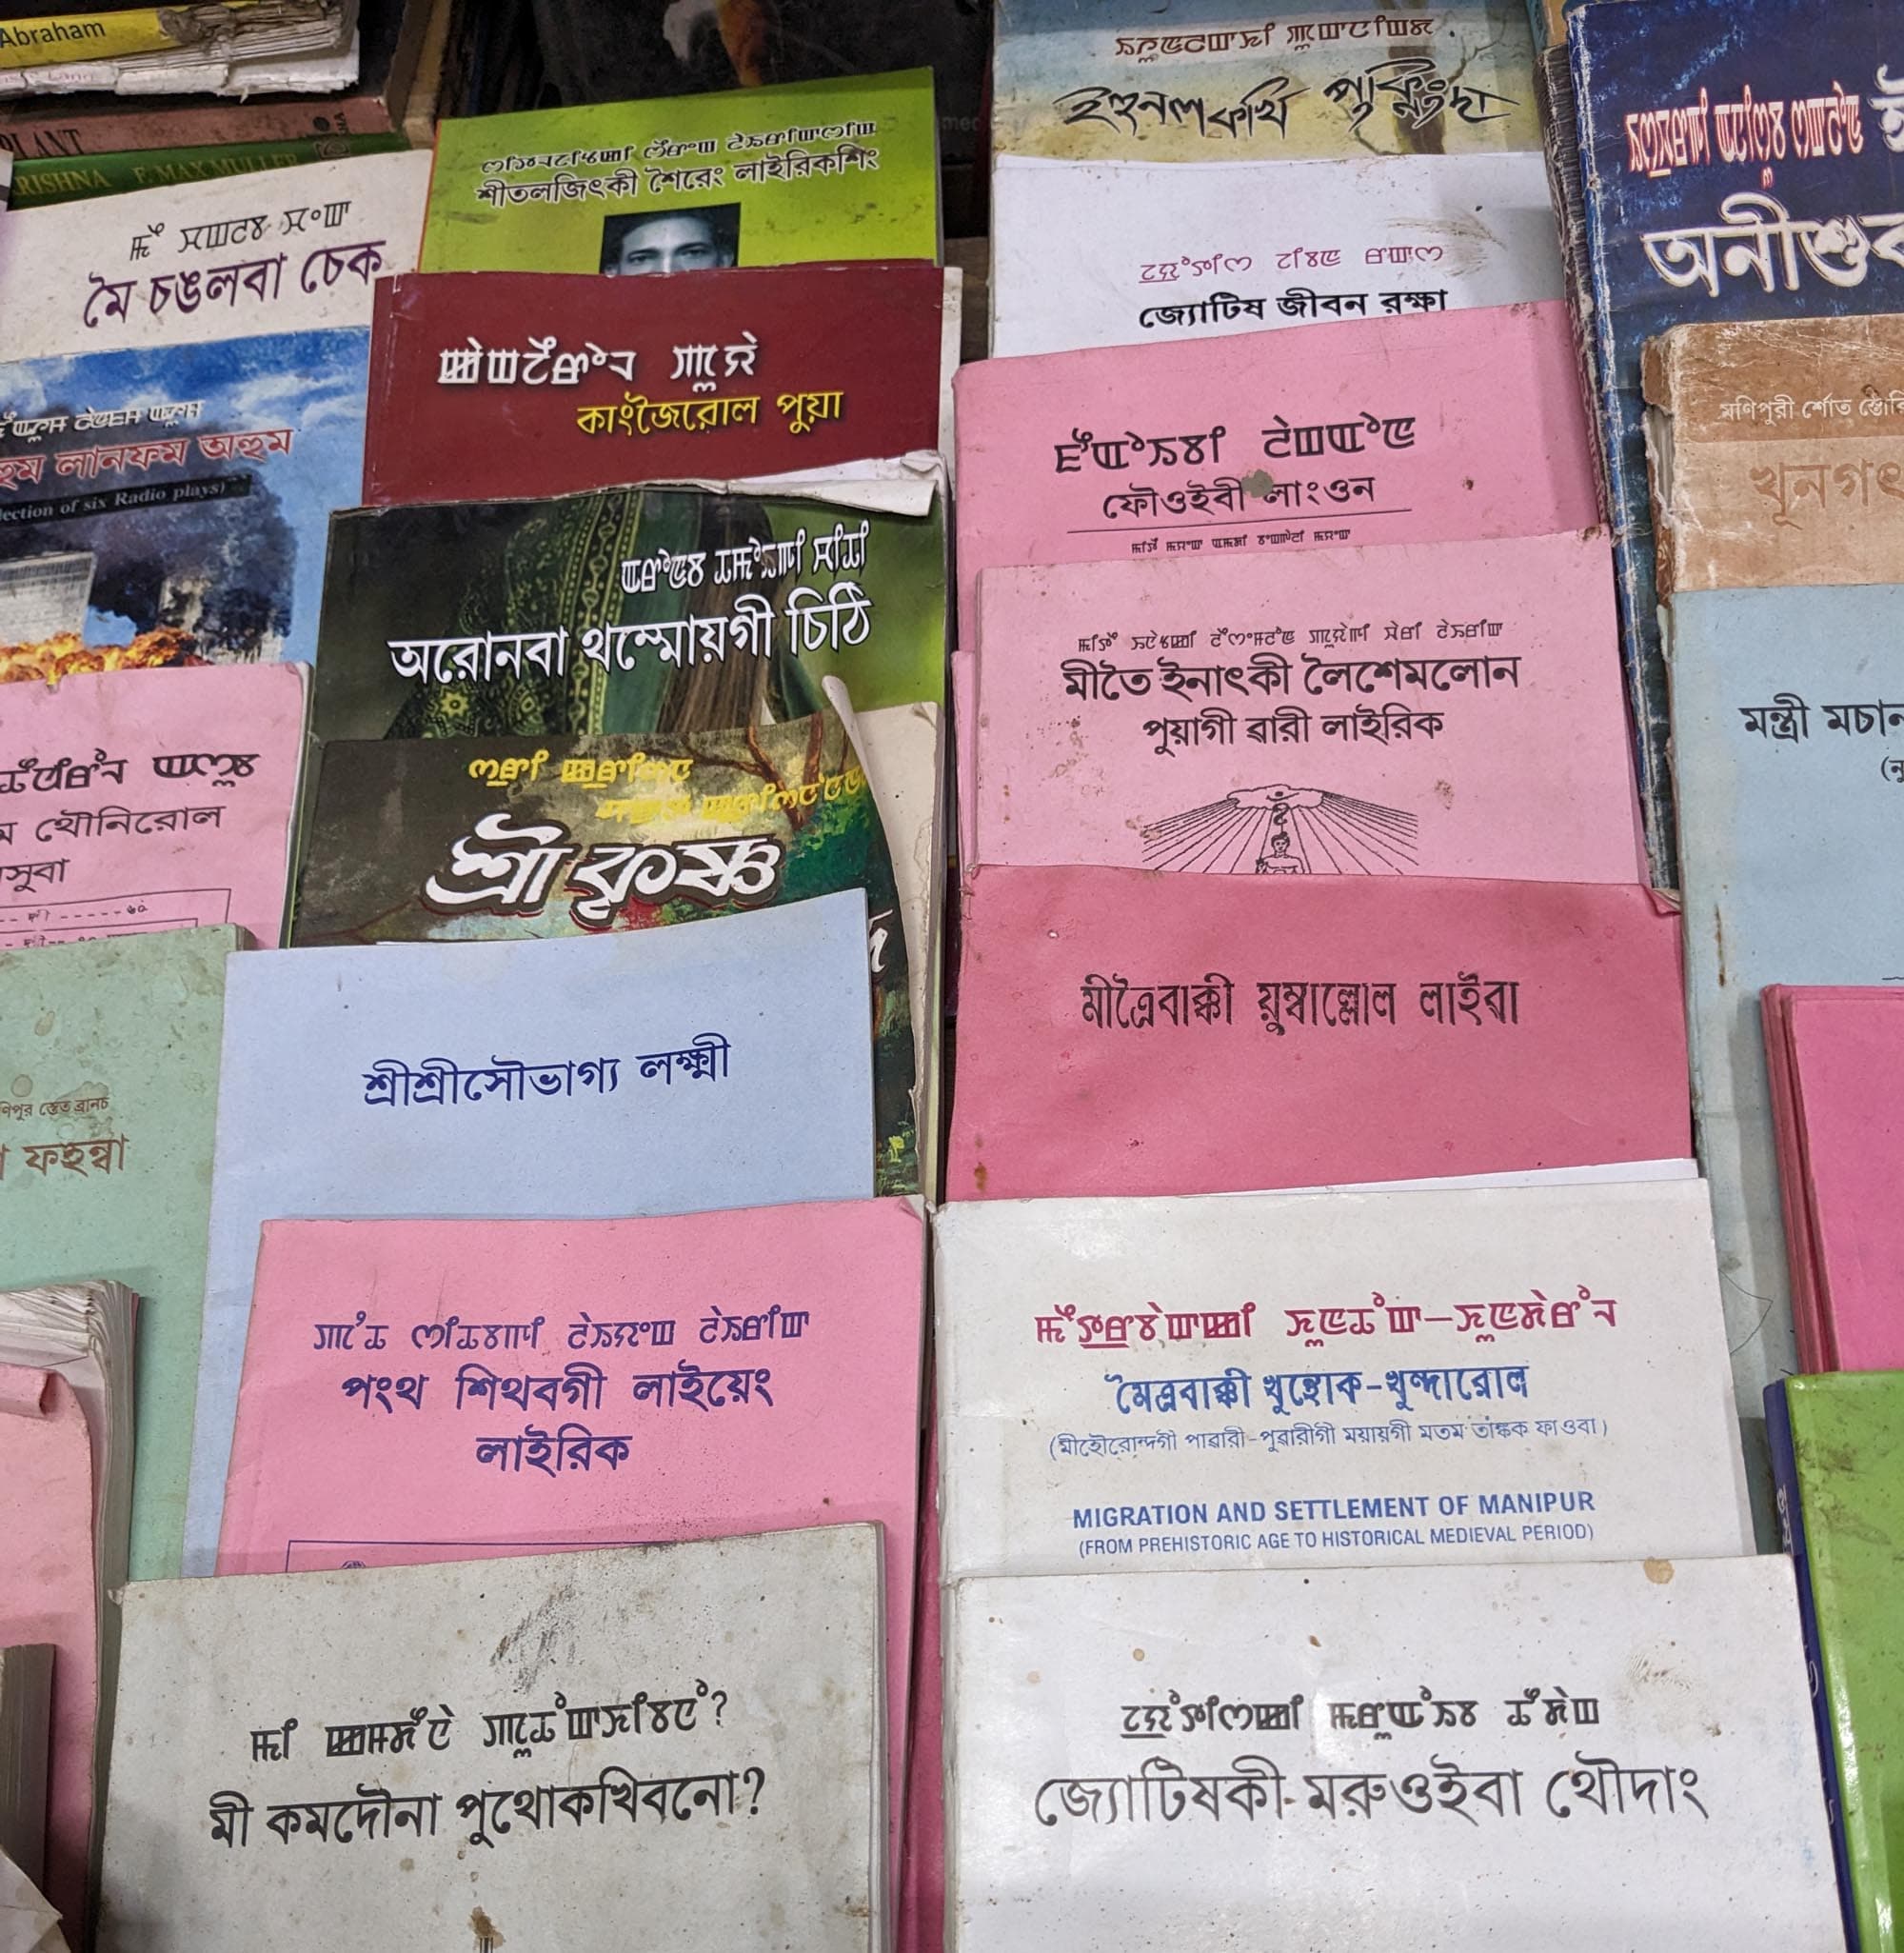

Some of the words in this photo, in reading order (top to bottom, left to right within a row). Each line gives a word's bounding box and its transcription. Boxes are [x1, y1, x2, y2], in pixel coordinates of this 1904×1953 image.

[0, 21, 106, 49] Abraham
[0, 129, 82, 158] PLANT
[15, 169, 111, 199] RISHNA
[157, 158, 205, 181] MAX
[209, 151, 298, 177] MULLER
[478, 168, 638, 208] শীতলজিৎকী
[647, 165, 724, 193] শৈরেং
[735, 143, 878, 183] লাইরিকশিং
[84, 271, 138, 329] মৈ
[150, 252, 288, 314] চঙলবা
[300, 240, 387, 294] চেক
[1276, 287, 1369, 320] জীবন
[1378, 287, 1449, 315] রক্ষা
[576, 390, 762, 436] কাংজৈরোল
[776, 390, 844, 433] পুয়া
[1719, 392, 1795, 427] মণিপুরী
[54, 438, 190, 479] লানফম
[196, 428, 295, 463] অহুম
[61, 500, 77, 515] of
[83, 496, 107, 512] six
[114, 488, 167, 507] Radio
[172, 483, 227, 503] plays)
[1102, 476, 1245, 521] ফৌওইবী
[387, 626, 569, 685] অরোনবা
[580, 590, 777, 671] থম্মোয়গী
[784, 581, 872, 656] চিঠি
[1060, 658, 1153, 702] মীতৈ
[1158, 651, 1294, 703] ইনাৎকী
[1301, 651, 1522, 694] লৈশেমলোন
[1141, 707, 1238, 757] পুয়াগী
[1320, 702, 1445, 746] লাইরিক
[1737, 692, 1811, 745] মন্ত্রী
[35, 806, 228, 843] থৌনিরোল
[0, 858, 71, 894] সুবা
[425, 812, 575, 908] শ্রী
[573, 837, 781, 922] কৃষ্ণ
[361, 1053, 622, 1108] শ্রীশ্রীসৌভাগ্য
[635, 1031, 733, 1086] লক্ষ্মী
[341, 1372, 430, 1415] পংথ
[455, 1361, 608, 1412] শিথবগী
[631, 1358, 775, 1414] লাইয়েং
[475, 1422, 633, 1478] লাইরিক
[1342, 1418, 1412, 1445] ময়ায়গী
[1418, 1423, 1464, 1441] মতম
[1073, 1502, 1208, 1529] MIGRATION
[1218, 1500, 1267, 1523] AND
[1275, 1495, 1431, 1523] SETTLEMENT
[1438, 1494, 1468, 1515] OF
[1473, 1490, 1596, 1515] MANIPUR
[1079, 1538, 1133, 1559] (FROM
[1138, 1533, 1253, 1555] PREHISTORIC
[1257, 1532, 1288, 1551] AGE
[1290, 1531, 1318, 1549] TO
[1322, 1528, 1425, 1549] HISTORICAL
[1430, 1525, 1519, 1546] MEDIEVAL
[1522, 1524, 1596, 1544] PERIOD)
[209, 1790, 254, 1847] মী
[266, 1784, 443, 1845] কমদৌনা
[455, 1765, 767, 1849] পুথোকখিবনো?
[1302, 1753, 1524, 1827] মরুওইবা
[1545, 1751, 1711, 1820] থৌদাং
